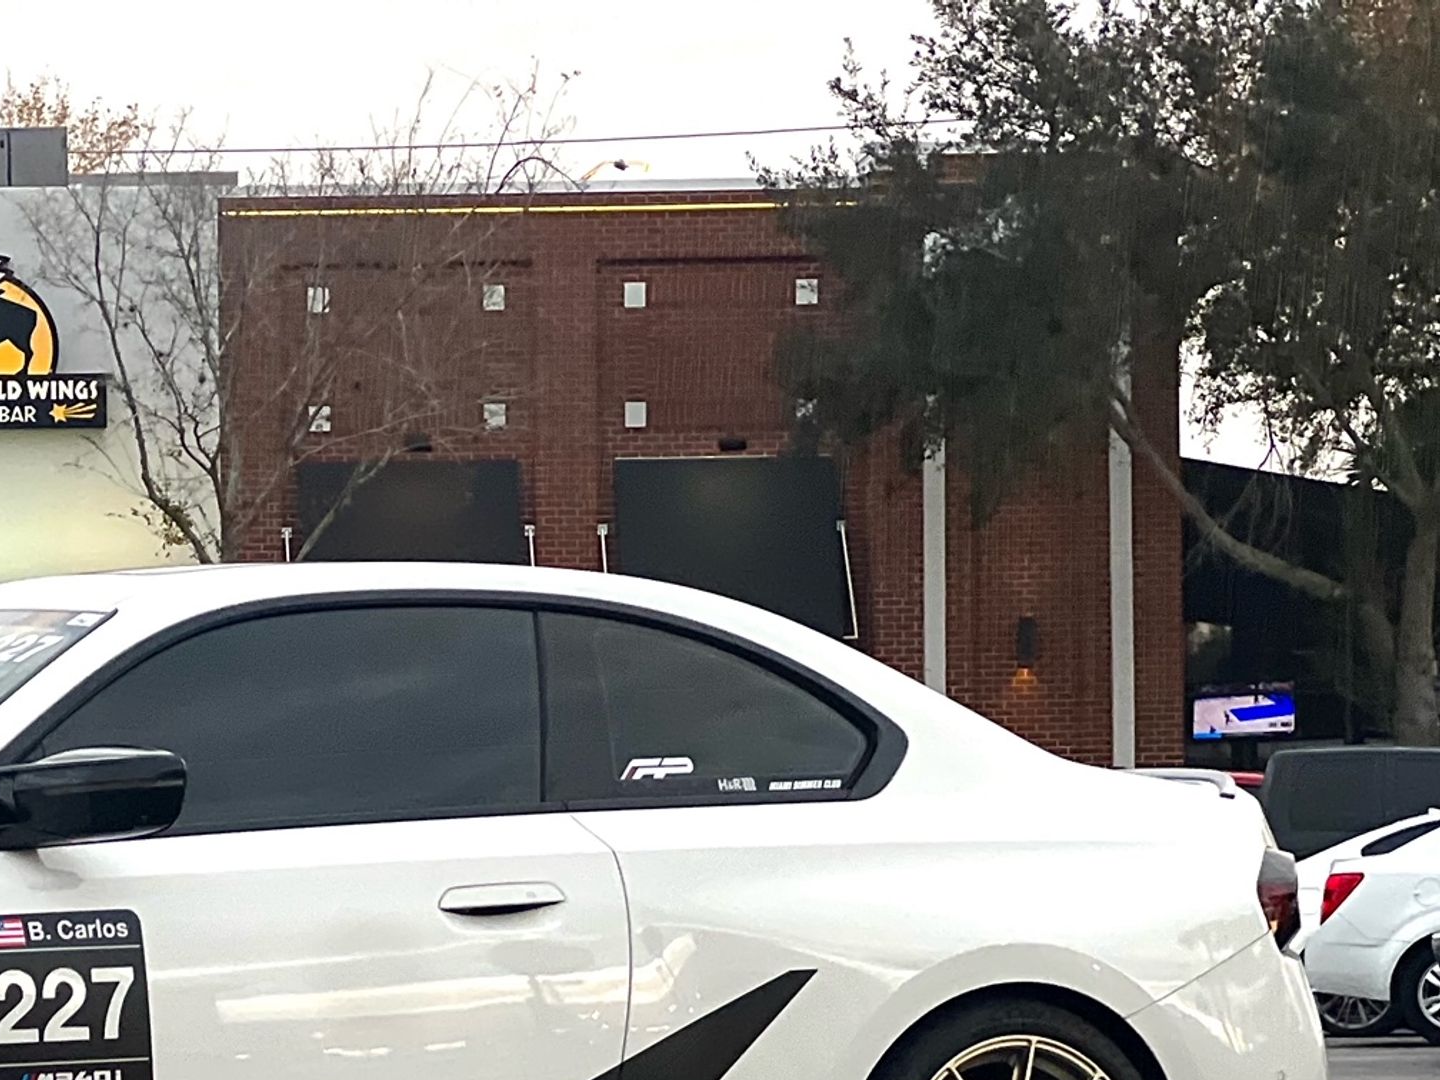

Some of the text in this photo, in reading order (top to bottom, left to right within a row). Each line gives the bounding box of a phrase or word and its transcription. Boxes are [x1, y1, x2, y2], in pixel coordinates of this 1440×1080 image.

[27, 379, 98, 400] WINGS
[27, 919, 129, 941] B. Carlos
